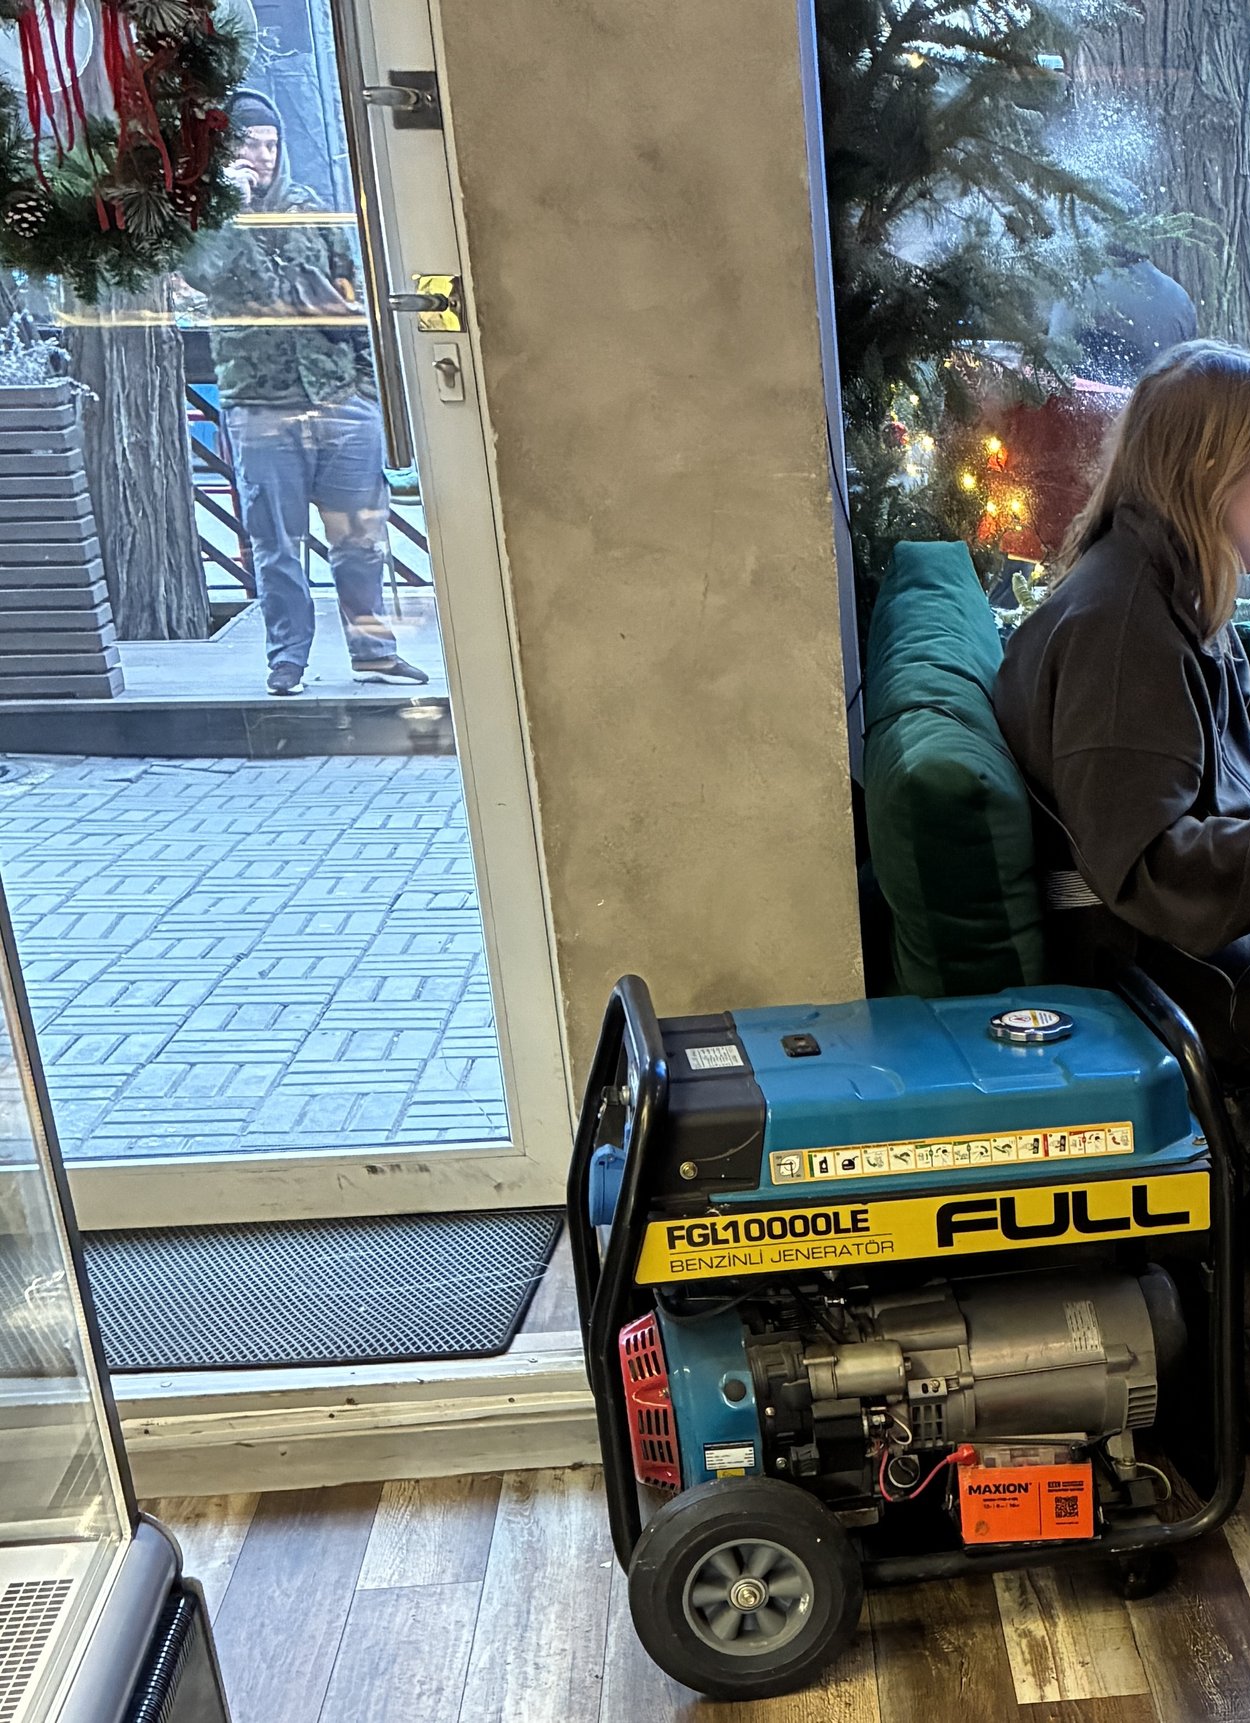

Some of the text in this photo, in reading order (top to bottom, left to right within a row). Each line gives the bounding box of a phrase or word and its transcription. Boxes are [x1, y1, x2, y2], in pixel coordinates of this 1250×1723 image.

[666, 1209, 871, 1250] FGL10000LE
[936, 1184, 1190, 1248] FULL
[670, 1239, 895, 1273] BENZİNLİ JENERATÖR
[968, 1482, 1029, 1496] MAXION
